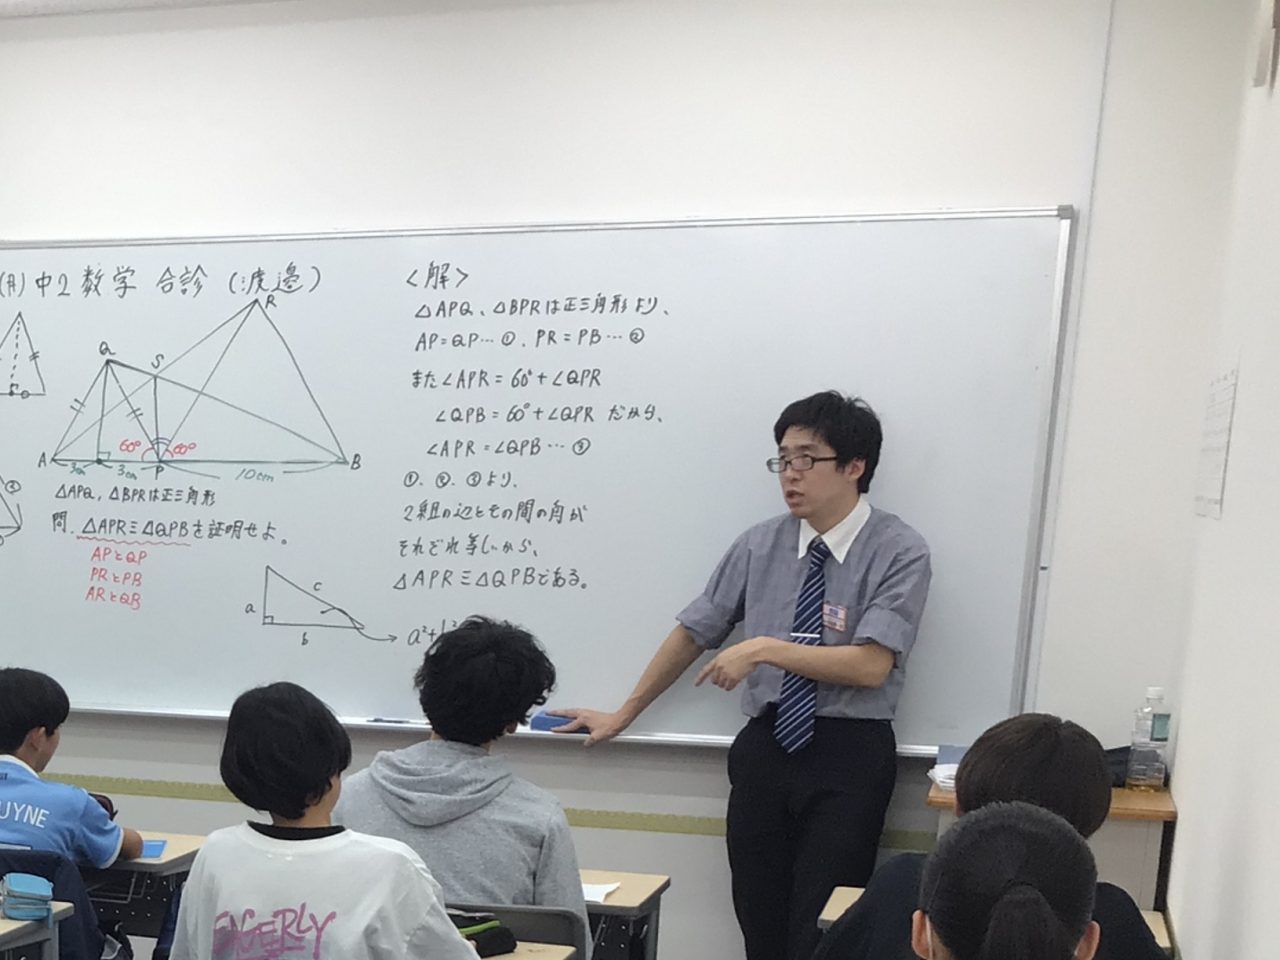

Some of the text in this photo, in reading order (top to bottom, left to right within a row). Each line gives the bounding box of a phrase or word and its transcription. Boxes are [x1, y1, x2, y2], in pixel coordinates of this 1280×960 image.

[81, 263, 137, 299] 数学
[264, 294, 277, 309] R
[37, 451, 47, 468] A
[350, 453, 362, 470] B
